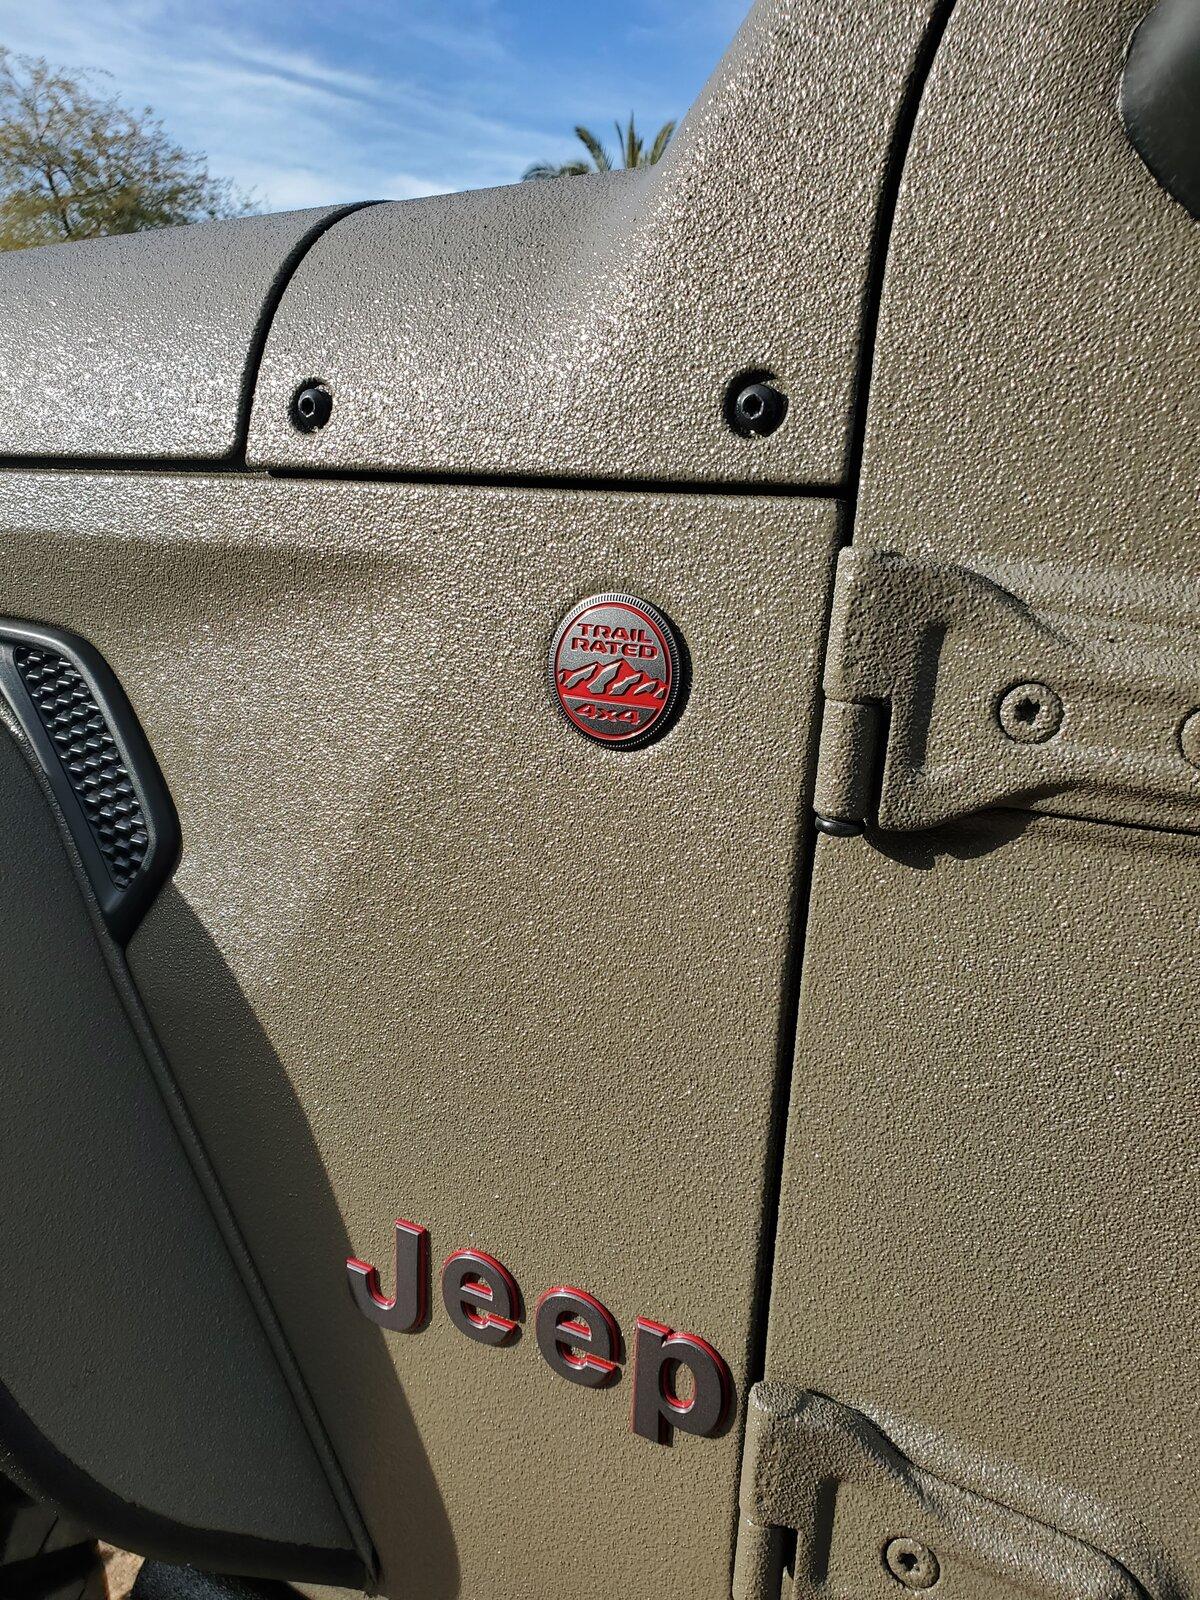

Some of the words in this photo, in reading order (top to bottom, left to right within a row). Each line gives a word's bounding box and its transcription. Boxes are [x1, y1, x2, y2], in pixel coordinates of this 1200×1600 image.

[577, 623, 653, 643] TRAIL
[571, 637, 659, 660] RATED
[346, 1217, 732, 1445] Jeep
